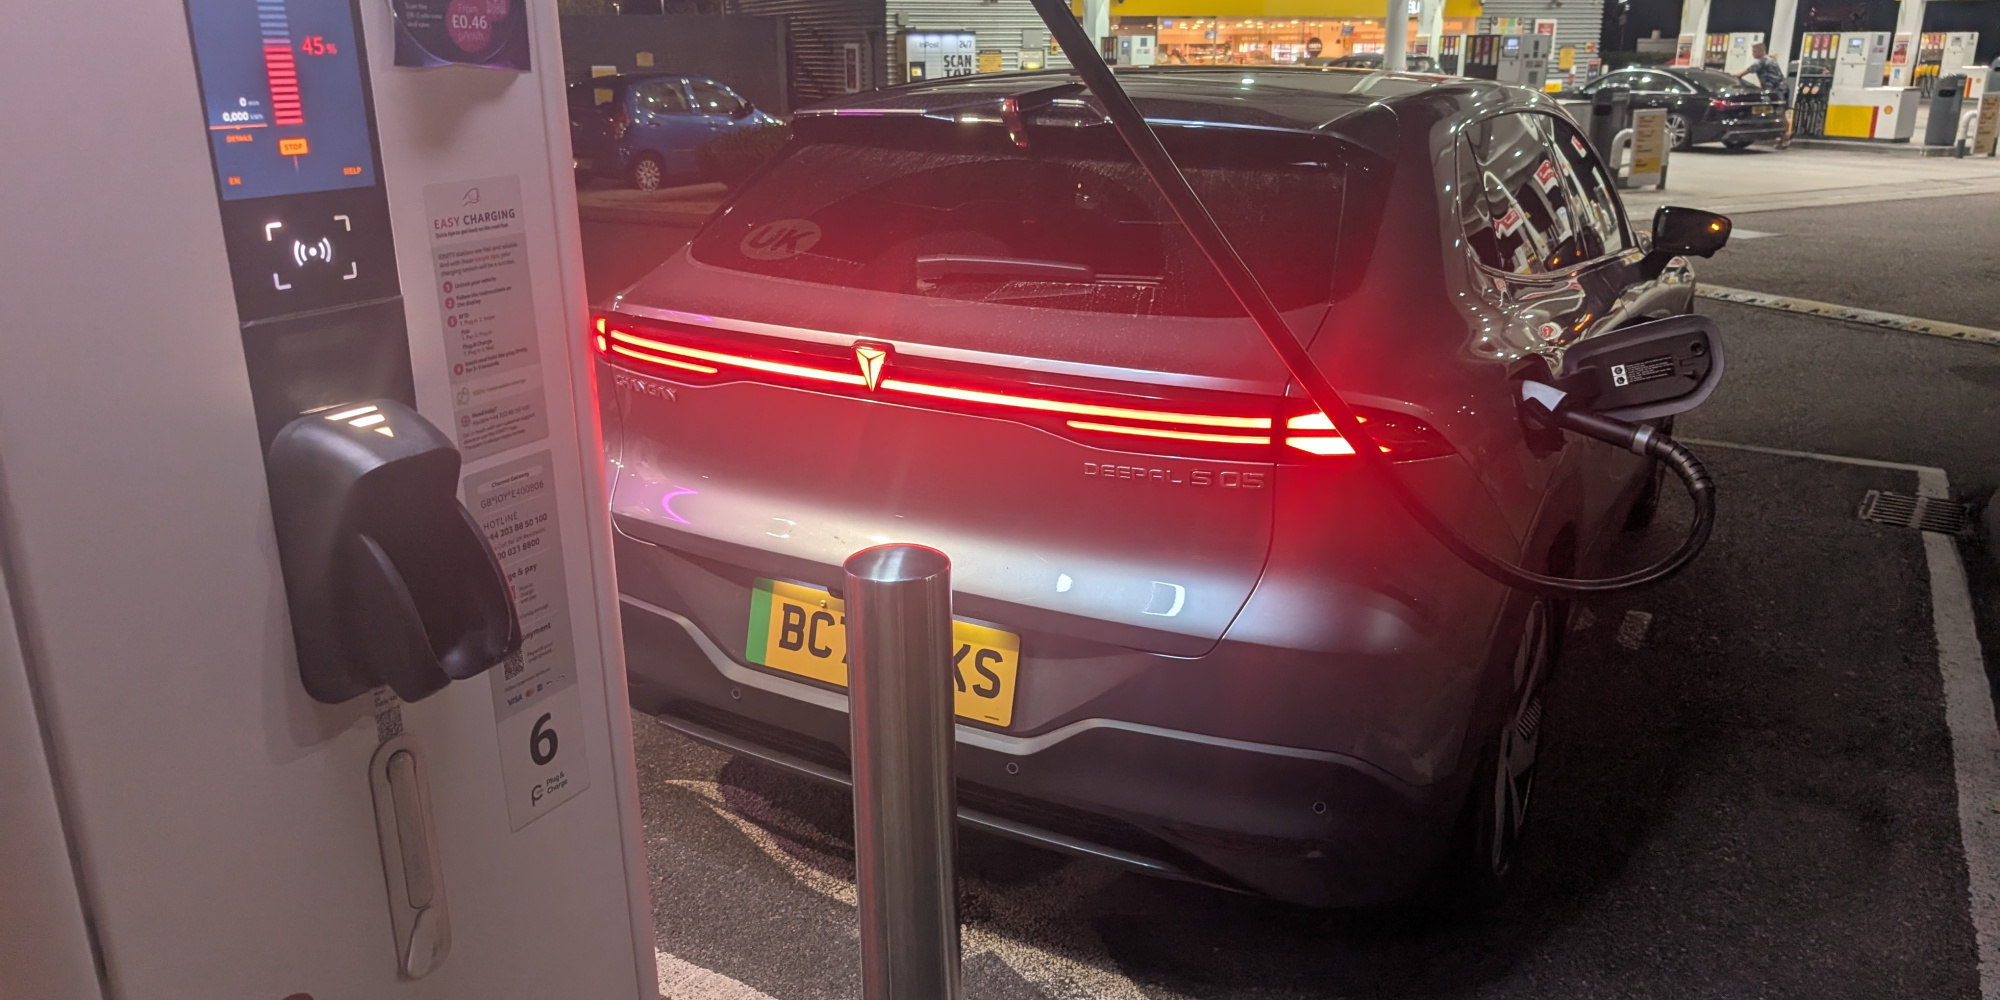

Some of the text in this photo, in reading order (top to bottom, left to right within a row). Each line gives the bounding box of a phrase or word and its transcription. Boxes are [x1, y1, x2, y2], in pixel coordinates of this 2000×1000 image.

[458, 4, 478, 14] From
[452, 14, 488, 29] £0.46
[960, 40, 972, 48] 24/7
[944, 54, 972, 68] SCAN
[239, 97, 247, 107] 0
[222, 111, 249, 122] 0,000
[226, 134, 253, 143] DETAILS
[284, 142, 303, 151] STOP
[343, 166, 362, 176] HELP
[228, 176, 242, 186] EN
[434, 208, 516, 230] EASY CHARGING
[748, 226, 816, 254] UK
[492, 472, 530, 488] Channel Gateway
[1084, 462, 1265, 488] DEEPAL S 05
[484, 512, 518, 531] HOTLINE
[500, 526, 513, 537] 203
[515, 522, 523, 532] 88
[525, 519, 533, 528] 50
[535, 513, 548, 524] 100
[508, 544, 521, 556] 031
[522, 538, 540, 551] 8800
[518, 568, 523, 576] &
[524, 564, 537, 575] pay
[778, 602, 848, 663] BC
[507, 694, 523, 706] VISA
[530, 712, 558, 766] 6
[546, 774, 560, 786] Plug
[547, 779, 568, 794] Charge
